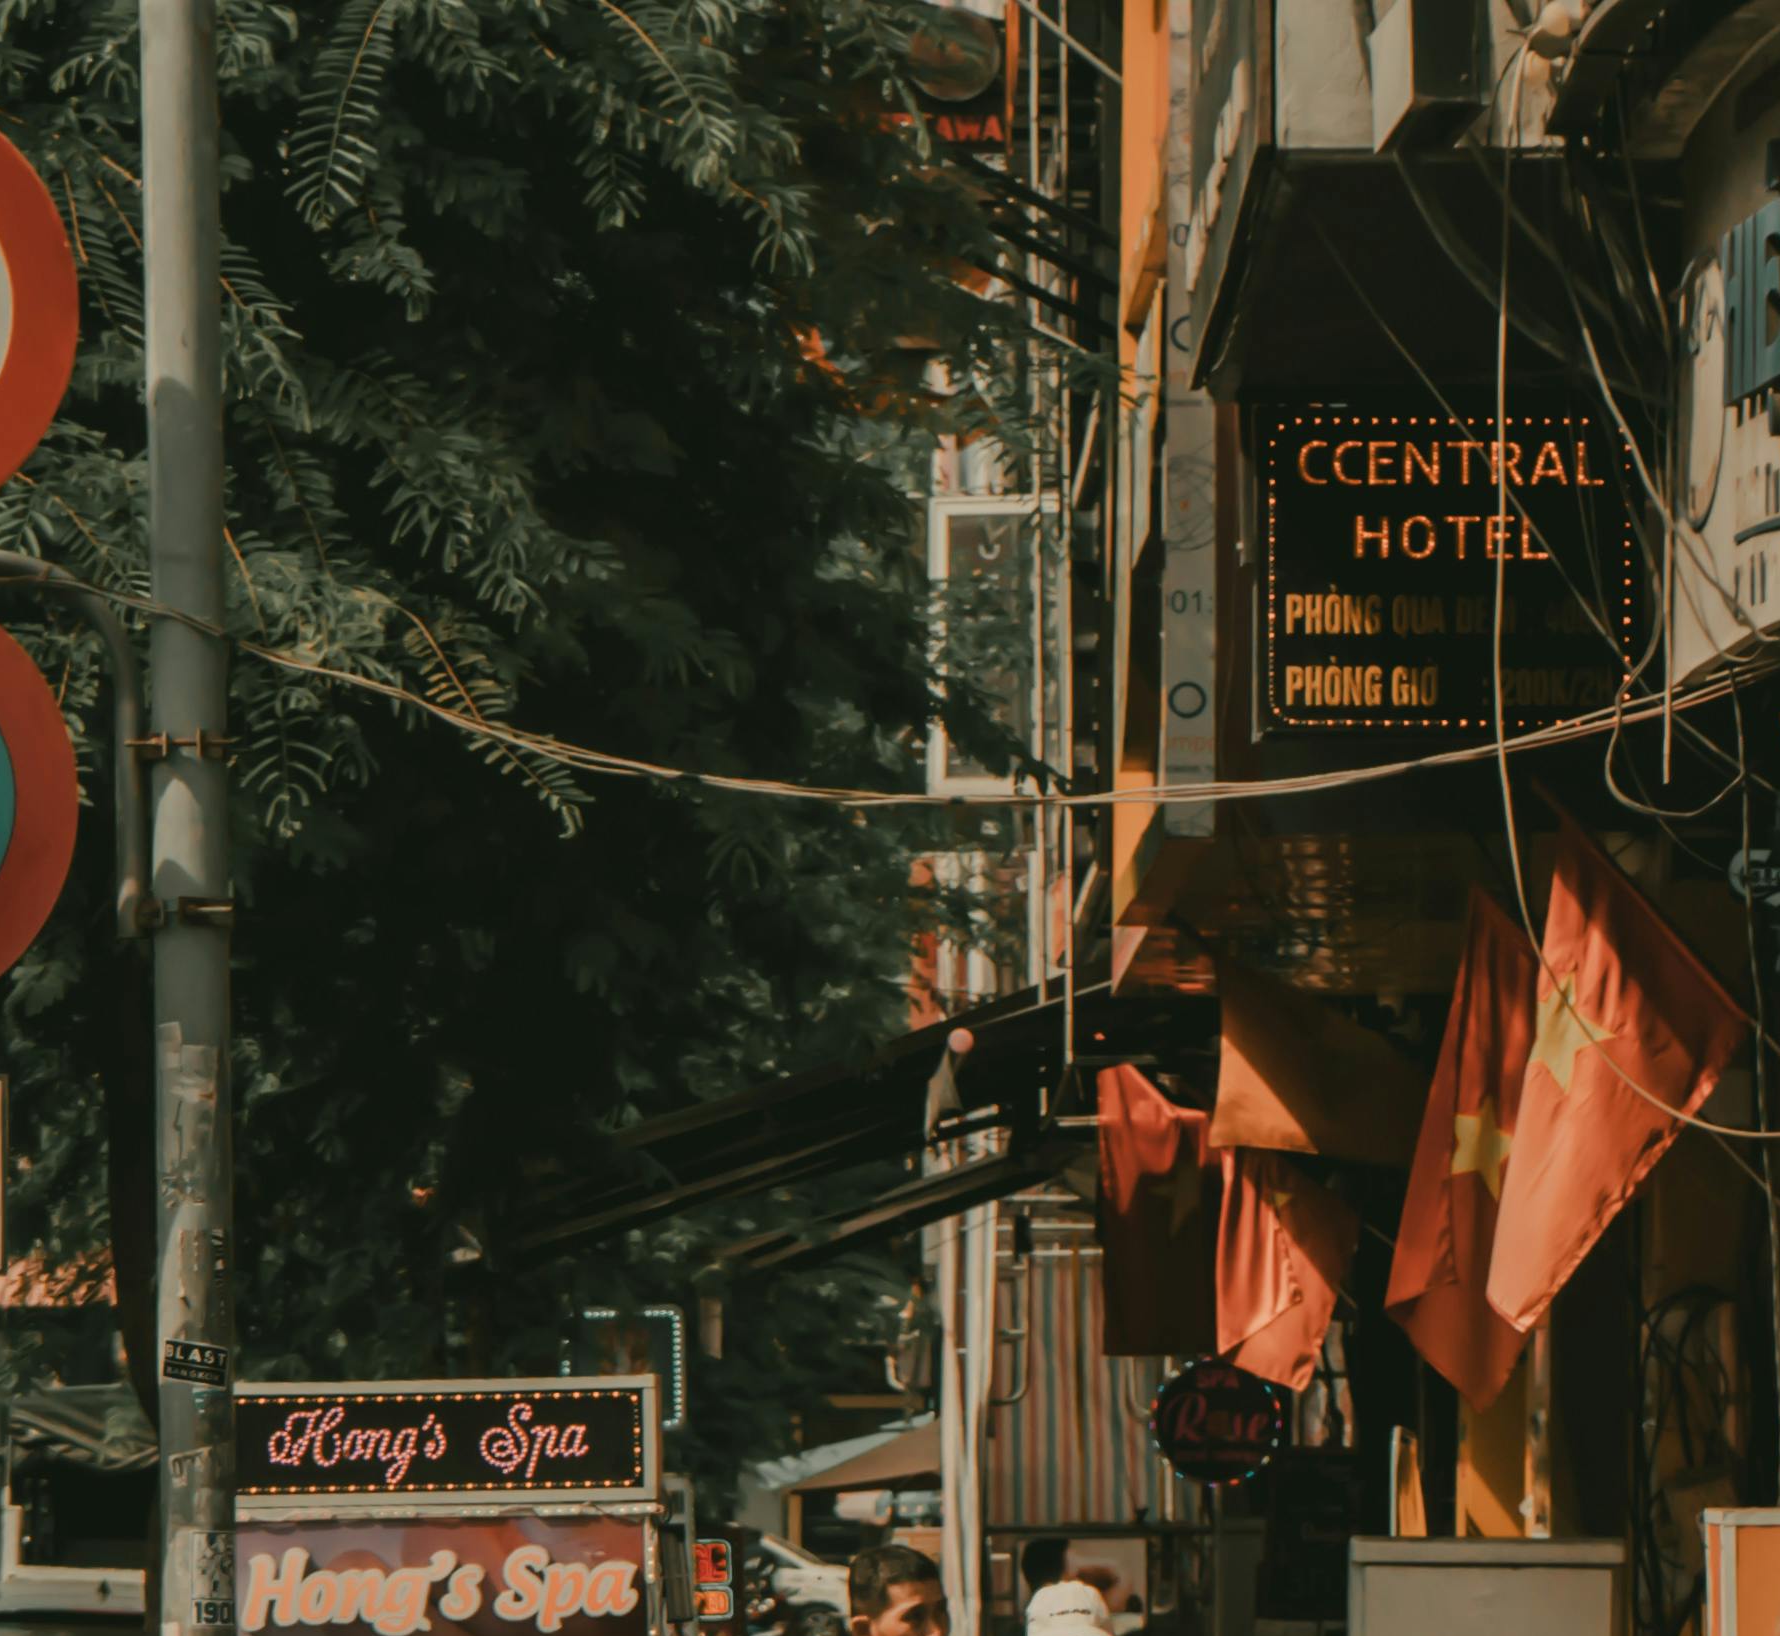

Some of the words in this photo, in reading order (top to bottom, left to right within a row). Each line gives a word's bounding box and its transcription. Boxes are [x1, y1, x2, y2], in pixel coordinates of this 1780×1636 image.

[1297, 440, 1604, 486] CCENTRAL
[1353, 514, 1551, 560] HOTEL
[1285, 584, 1381, 635] PHÒNG
[1285, 656, 1381, 707] PHÒNG
[268, 1405, 448, 1485] Hong's
[478, 1402, 590, 1478] Spa
[493, 1544, 640, 1633] Spa
